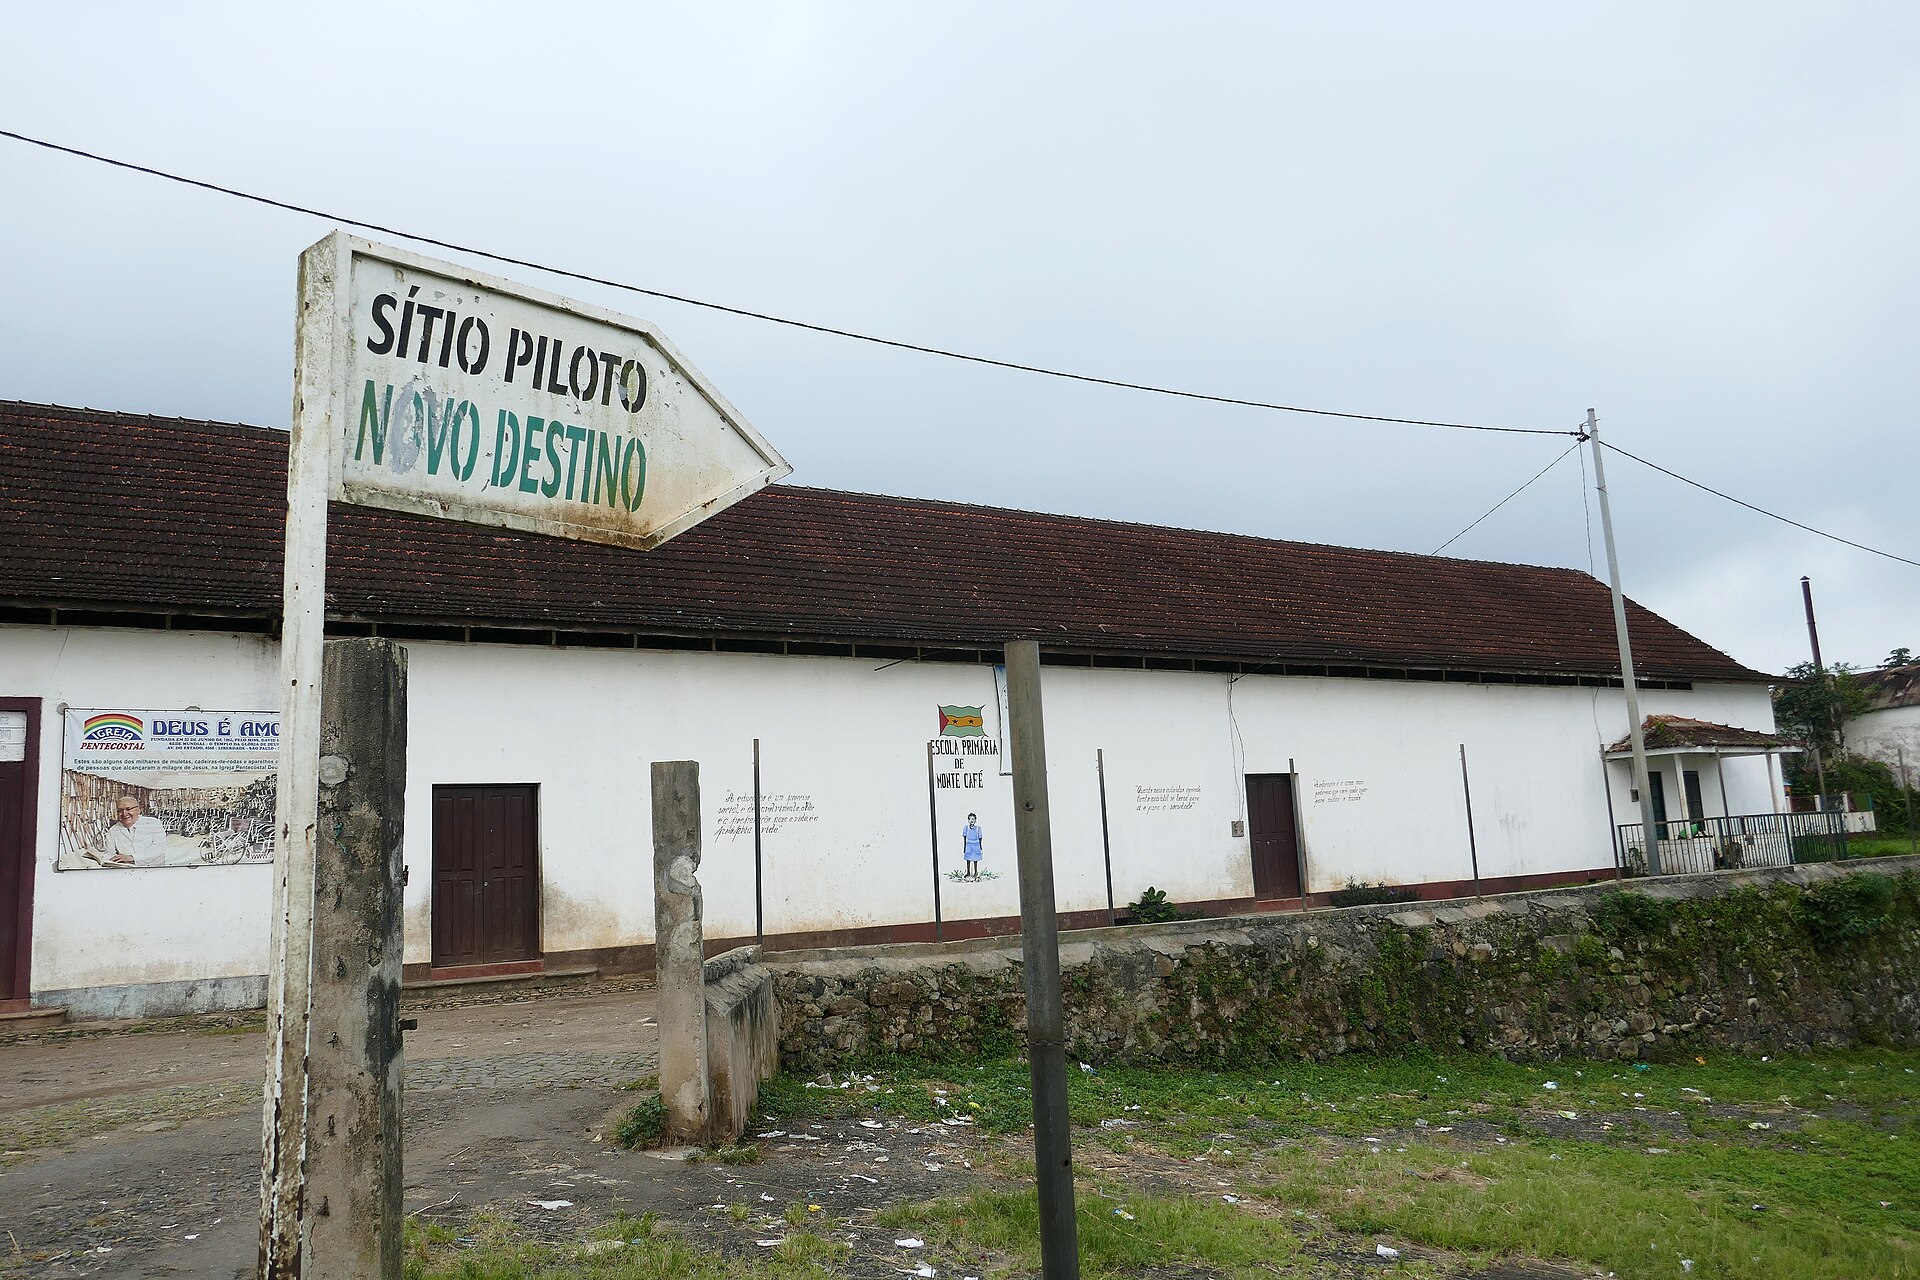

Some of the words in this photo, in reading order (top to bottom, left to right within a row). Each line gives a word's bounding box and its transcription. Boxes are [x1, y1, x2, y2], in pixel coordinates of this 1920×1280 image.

[367, 285, 490, 375] SÍTIO
[504, 327, 647, 413] PILOTO
[354, 379, 480, 482] NOVO
[490, 408, 647, 512] DESTINO
[91, 728, 134, 740] IGREJA
[152, 720, 209, 736] DEUS
[217, 717, 231, 736] É
[240, 721, 280, 737] AMO
[80, 742, 146, 750] PENTECOSTAL
[930, 739, 960, 756] ESCOLA
[961, 736, 999, 756] PRIMÁRIA
[103, 758, 123, 766] alguns
[248, 758, 274, 766] aparelhos
[954, 758, 965, 769] DE
[936, 772, 961, 789] MONTE
[963, 769, 984, 789] CAFÉ
